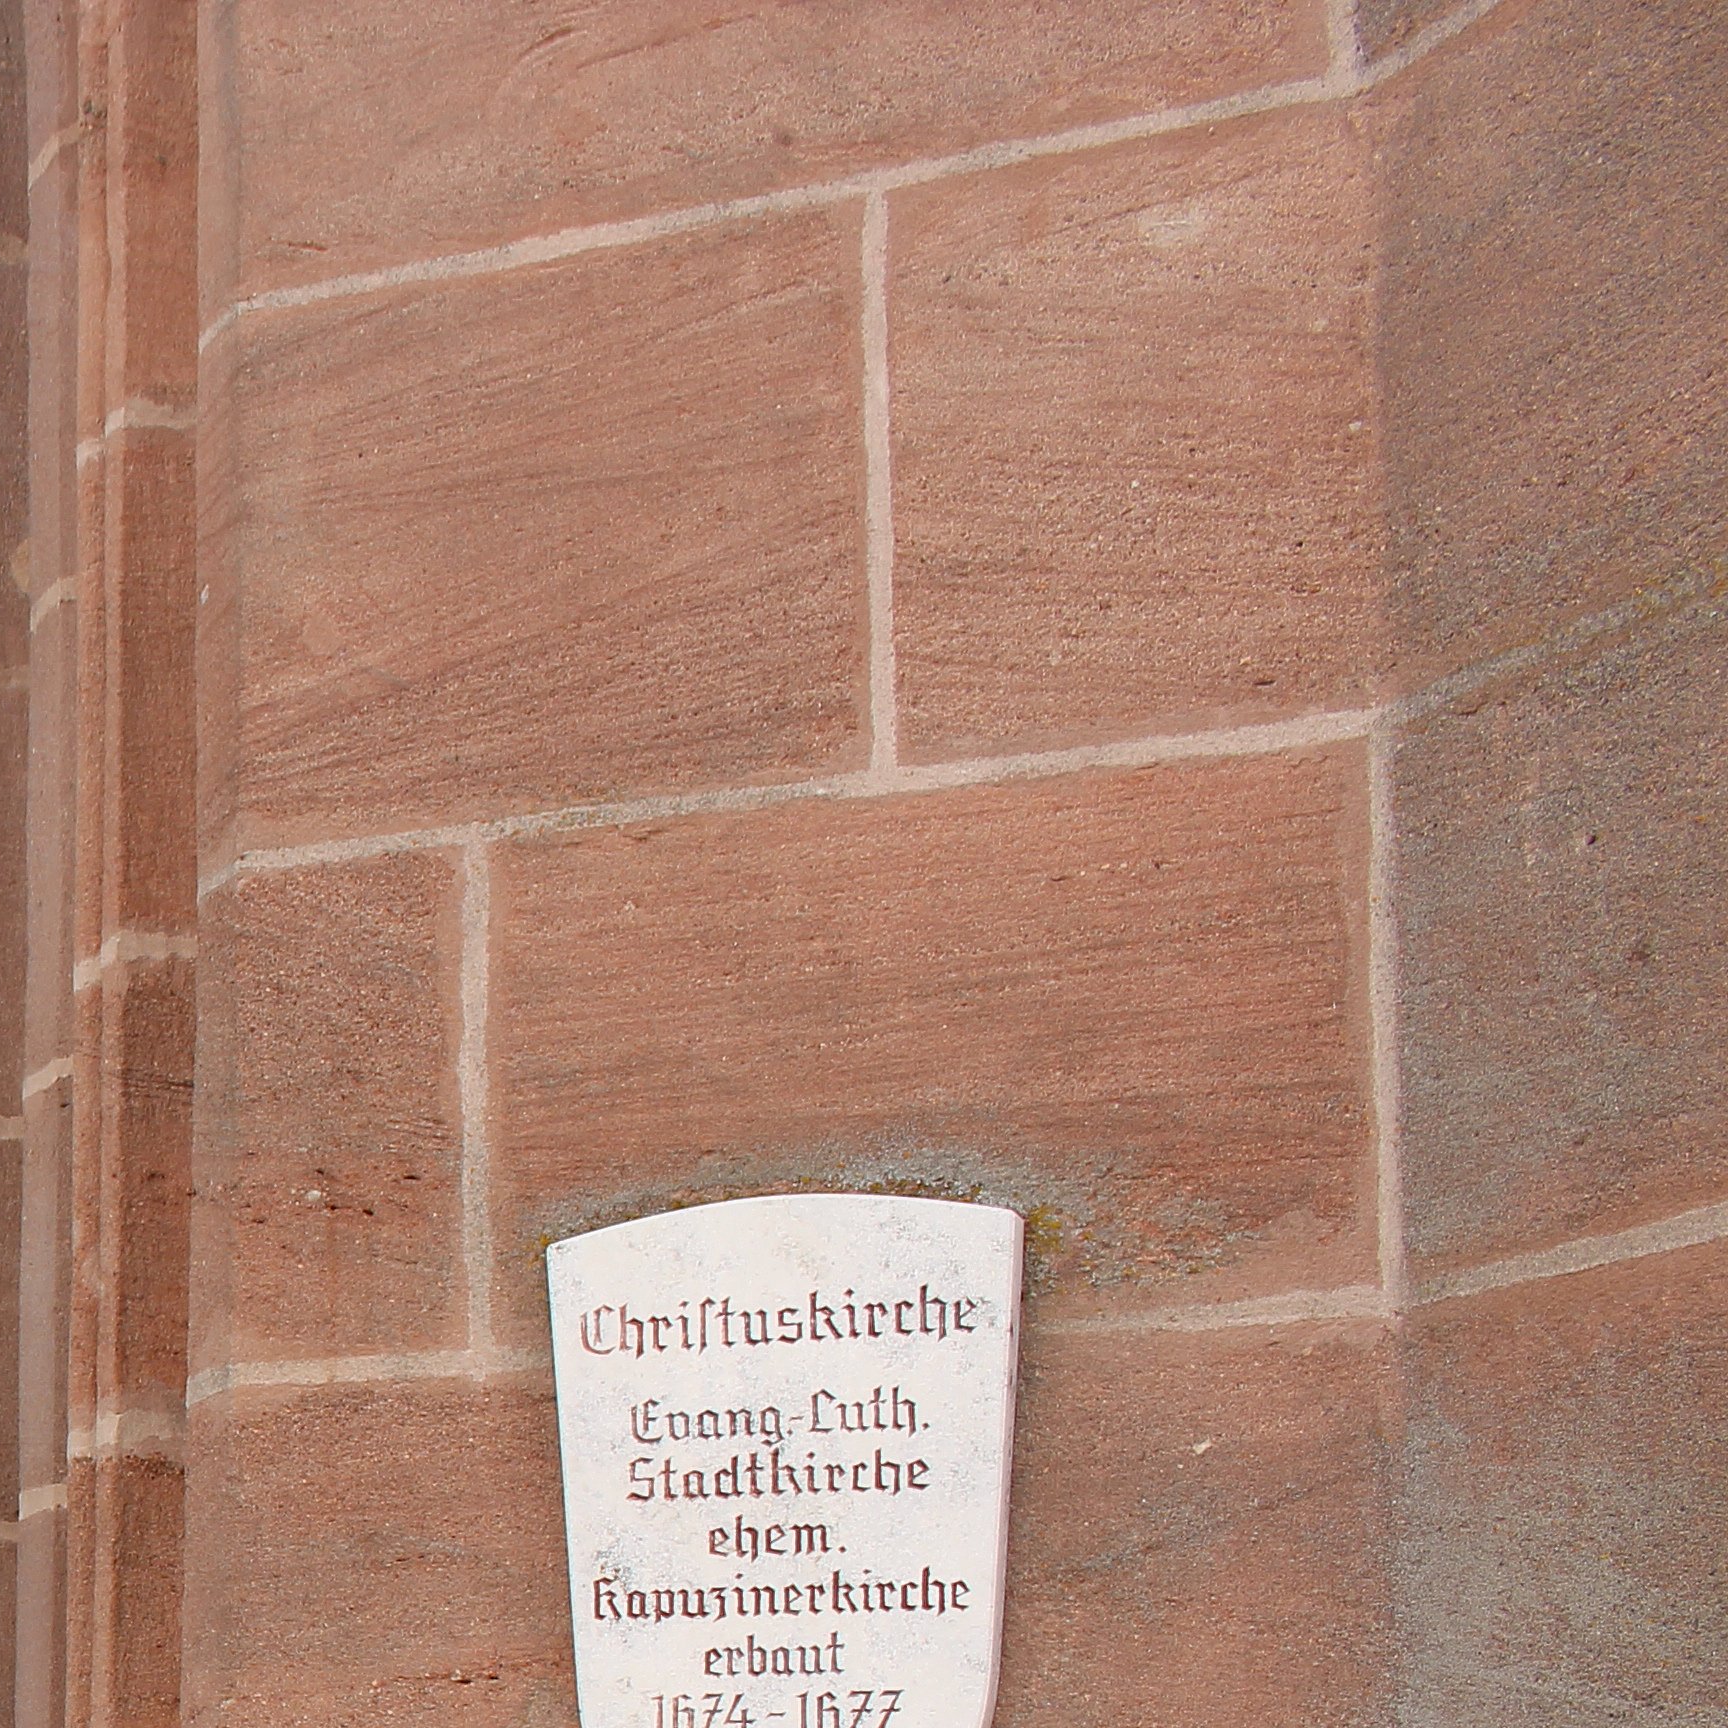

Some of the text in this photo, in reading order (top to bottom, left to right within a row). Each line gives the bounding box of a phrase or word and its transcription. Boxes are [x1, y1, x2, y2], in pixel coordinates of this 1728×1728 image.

[626, 1447, 931, 1501] Stadtkirche
[707, 1516, 847, 1562] ehem.
[592, 1567, 971, 1622] Kapuzinerkirche
[703, 1631, 846, 1678] erbaut
